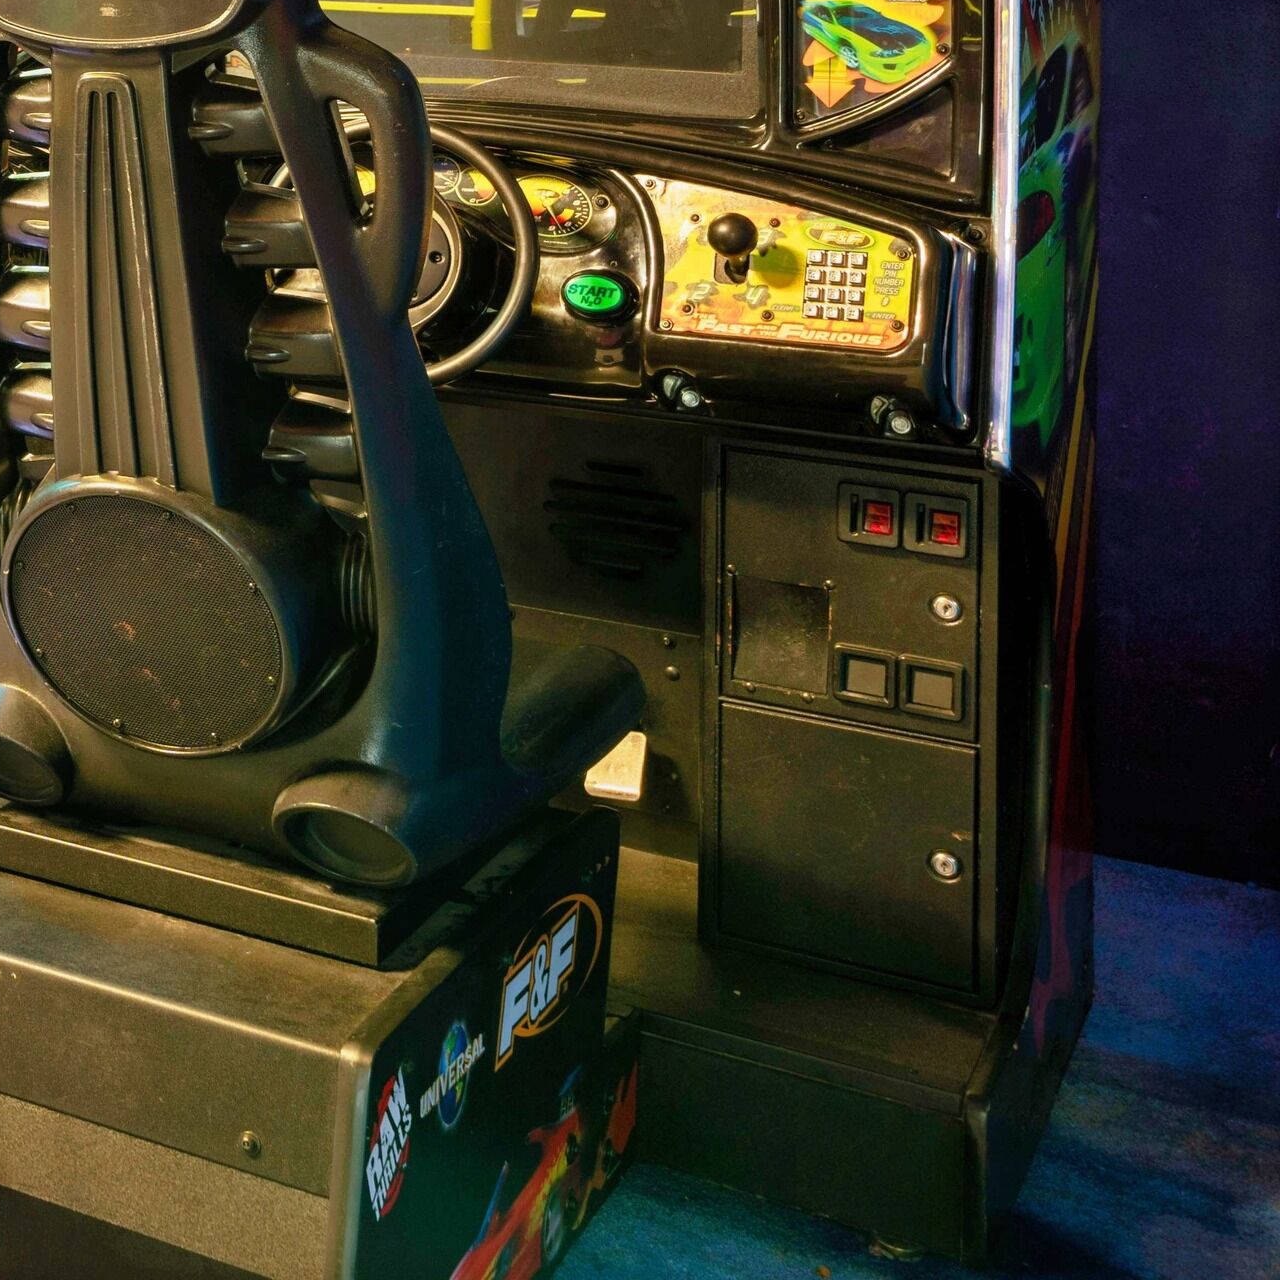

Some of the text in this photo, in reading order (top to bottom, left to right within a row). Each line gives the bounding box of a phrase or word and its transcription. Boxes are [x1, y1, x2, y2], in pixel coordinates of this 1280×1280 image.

[874, 279, 904, 287] NUMBER
[883, 270, 897, 278] PIN
[568, 283, 618, 298] START
[691, 283, 710, 299] 2
[746, 285, 765, 305] 4
[875, 287, 900, 295] PRESS
[698, 319, 757, 336] FAST
[777, 322, 885, 346] FURIOUS
[498, 913, 578, 1058] F&F
[420, 1033, 486, 1119] UNIVERSAL
[366, 1066, 407, 1205] RAW
[372, 1103, 412, 1222] THRILLS
